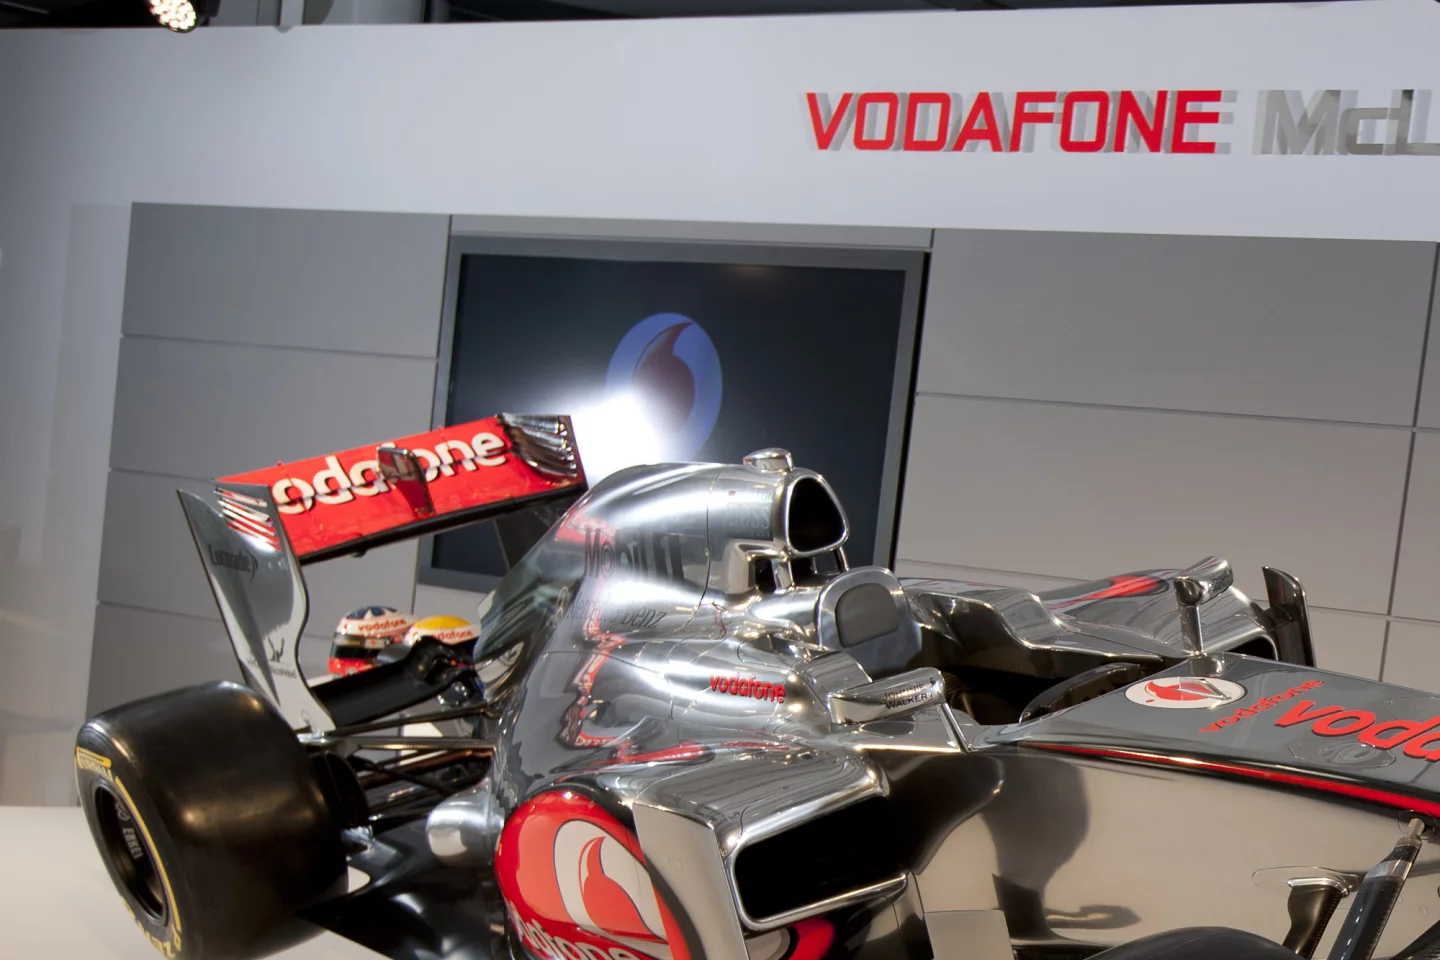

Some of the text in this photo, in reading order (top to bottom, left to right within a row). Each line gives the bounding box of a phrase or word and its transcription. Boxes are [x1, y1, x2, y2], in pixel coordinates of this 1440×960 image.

[806, 90, 1222, 154] VODAFONE
[710, 673, 786, 704] vodafone
[885, 692, 928, 709] WALKER
[1198, 679, 1325, 733] vodafone
